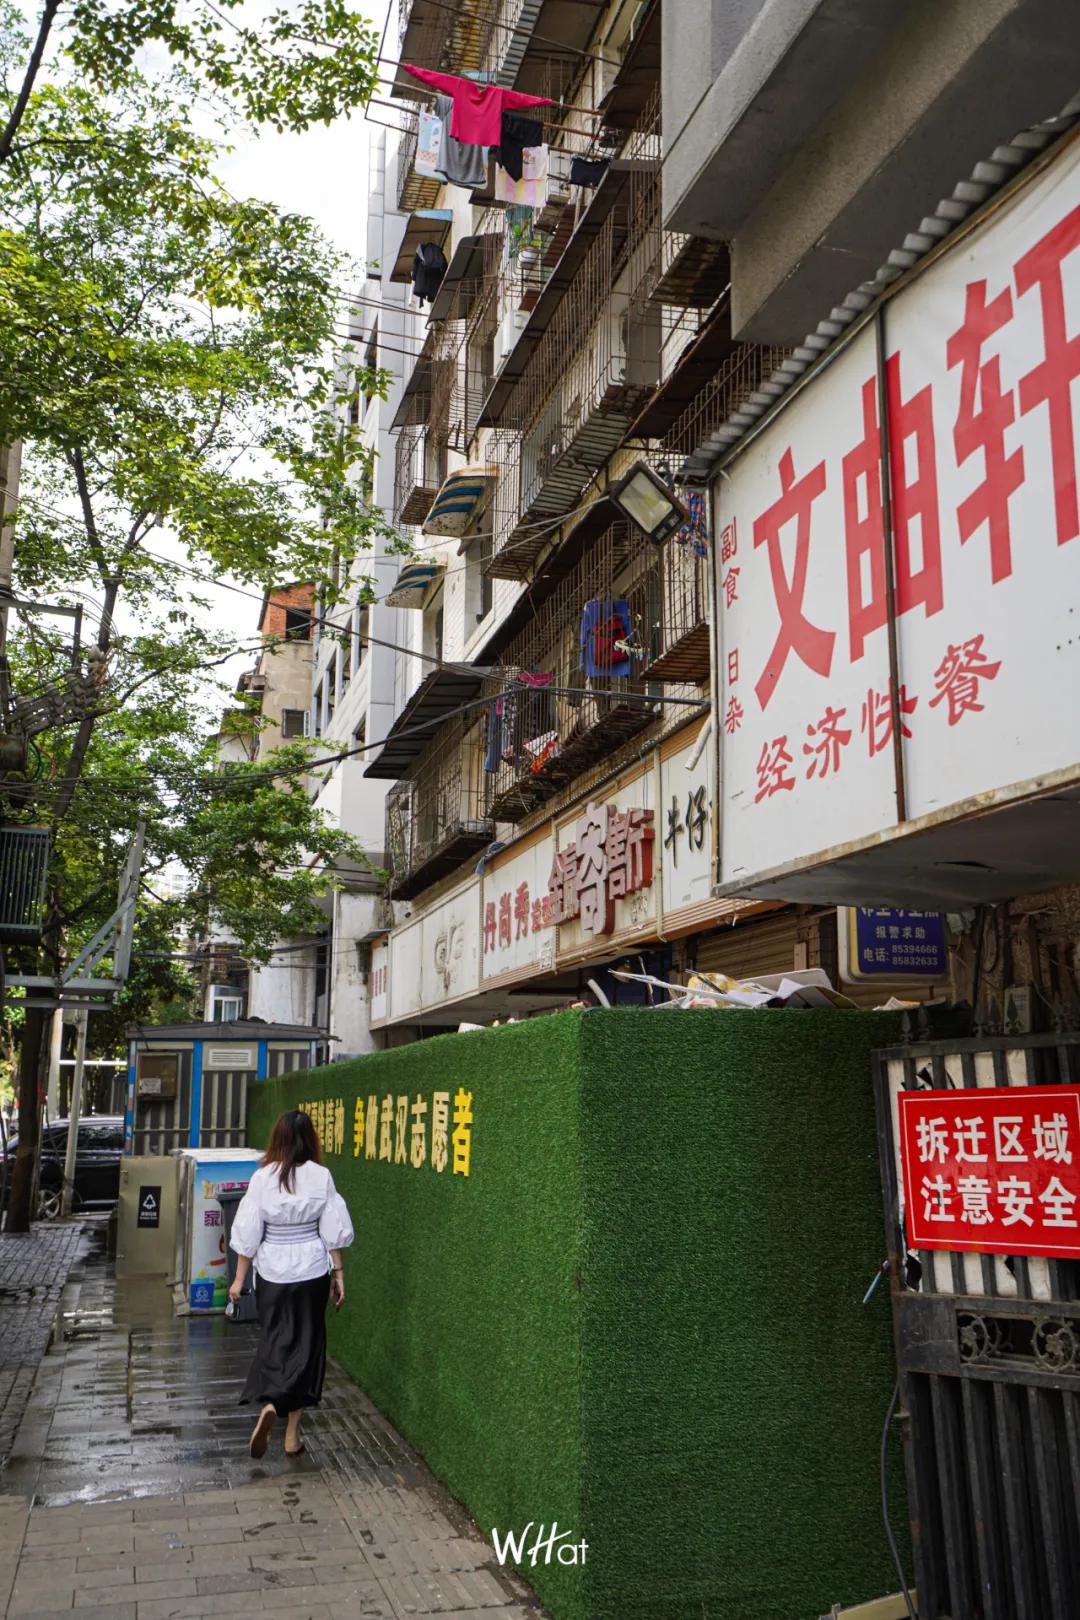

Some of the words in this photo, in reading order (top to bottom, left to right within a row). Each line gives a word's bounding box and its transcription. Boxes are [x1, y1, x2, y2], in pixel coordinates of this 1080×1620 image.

[752, 204, 1080, 712] 文曲轩
[719, 515, 741, 609] 副食
[723, 648, 743, 735] 日杂
[754, 633, 1002, 804] 经济快餐
[664, 784, 713, 868] 牛仔
[876, 926, 925, 939] 报警求助
[354, 1087, 473, 1177] 争做武汉志愿者
[914, 1112, 1073, 1165] 拆迁区域
[920, 1174, 1079, 1228] 注意安全
